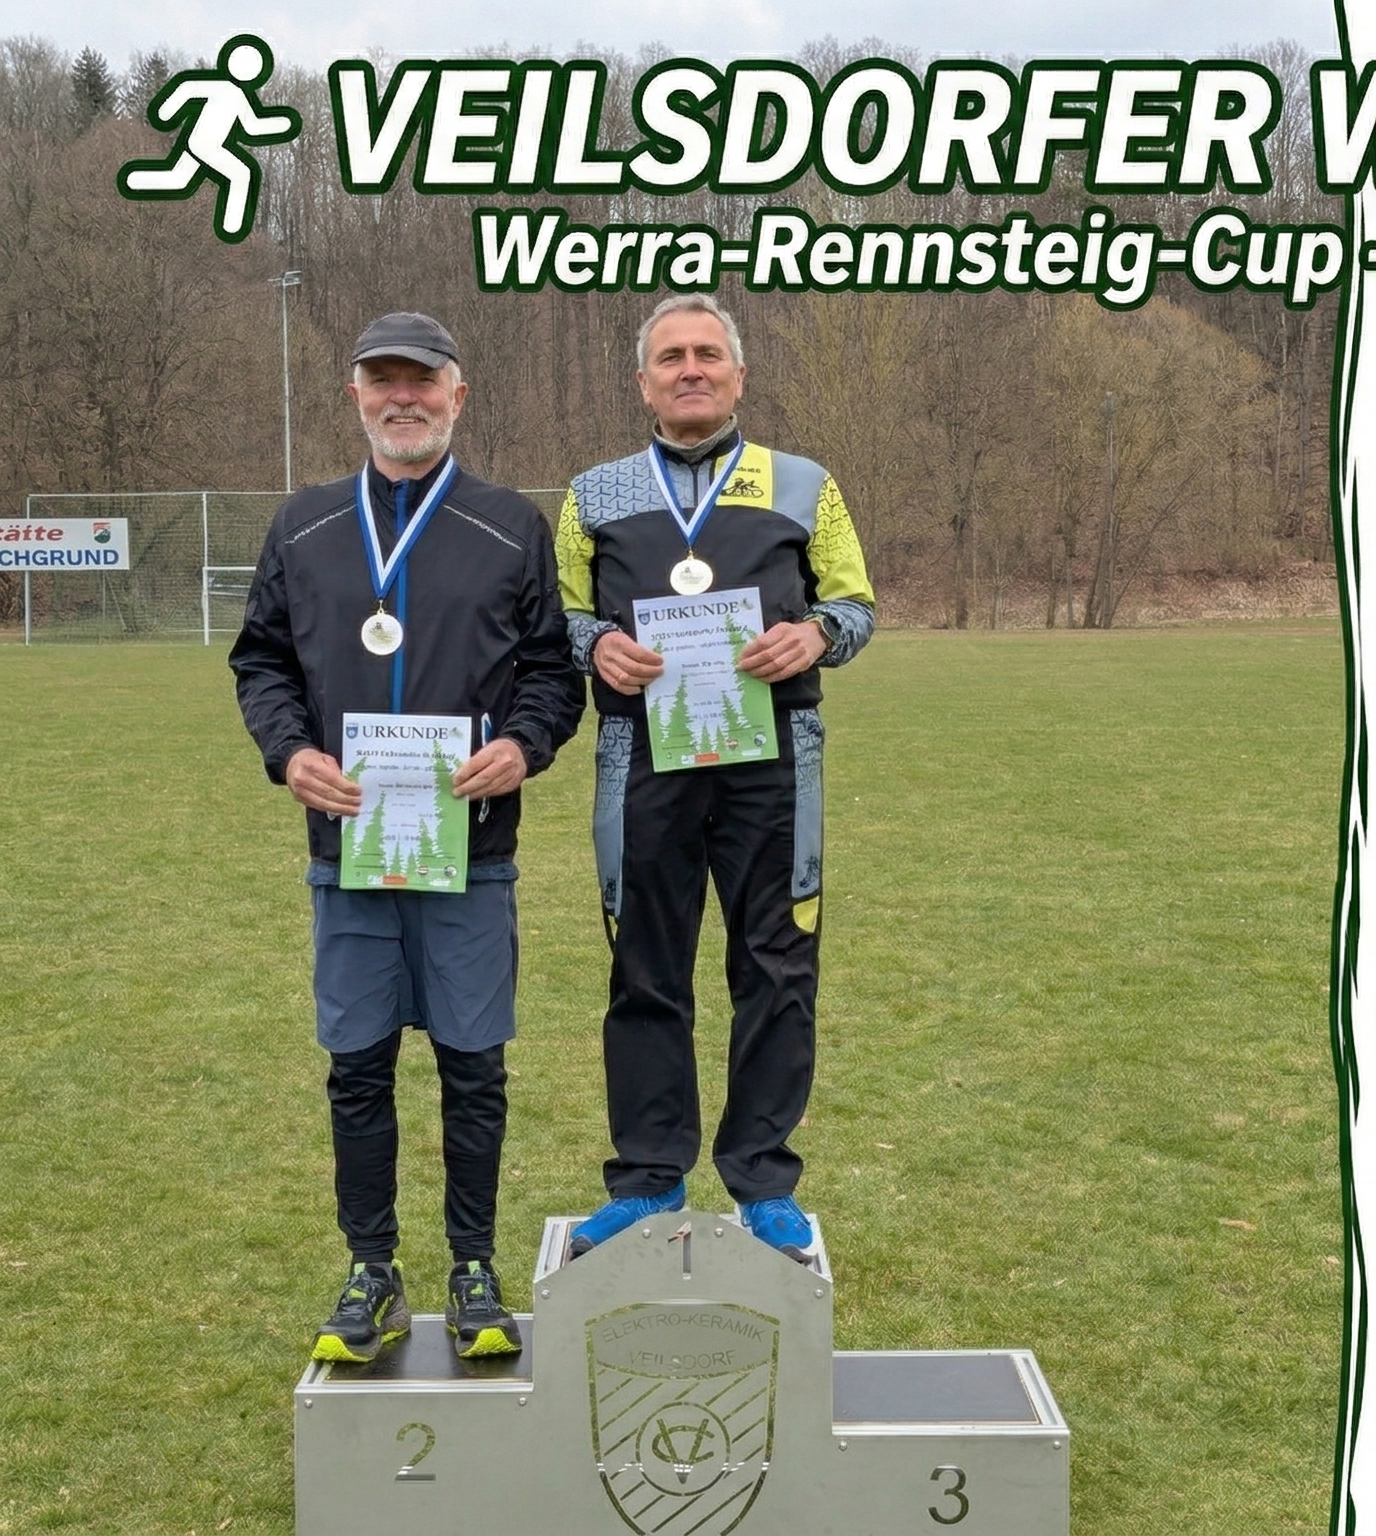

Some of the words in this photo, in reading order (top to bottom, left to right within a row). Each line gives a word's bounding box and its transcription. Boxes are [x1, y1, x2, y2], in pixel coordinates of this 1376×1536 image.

[653, 601, 740, 621] URKUNDE
[362, 725, 449, 740] URKUNDE
[667, 1220, 692, 1280] 1
[601, 1311, 767, 1343] ELEKTRO-KERAMIK
[394, 1422, 437, 1482] 2
[928, 1465, 969, 1525] 3
